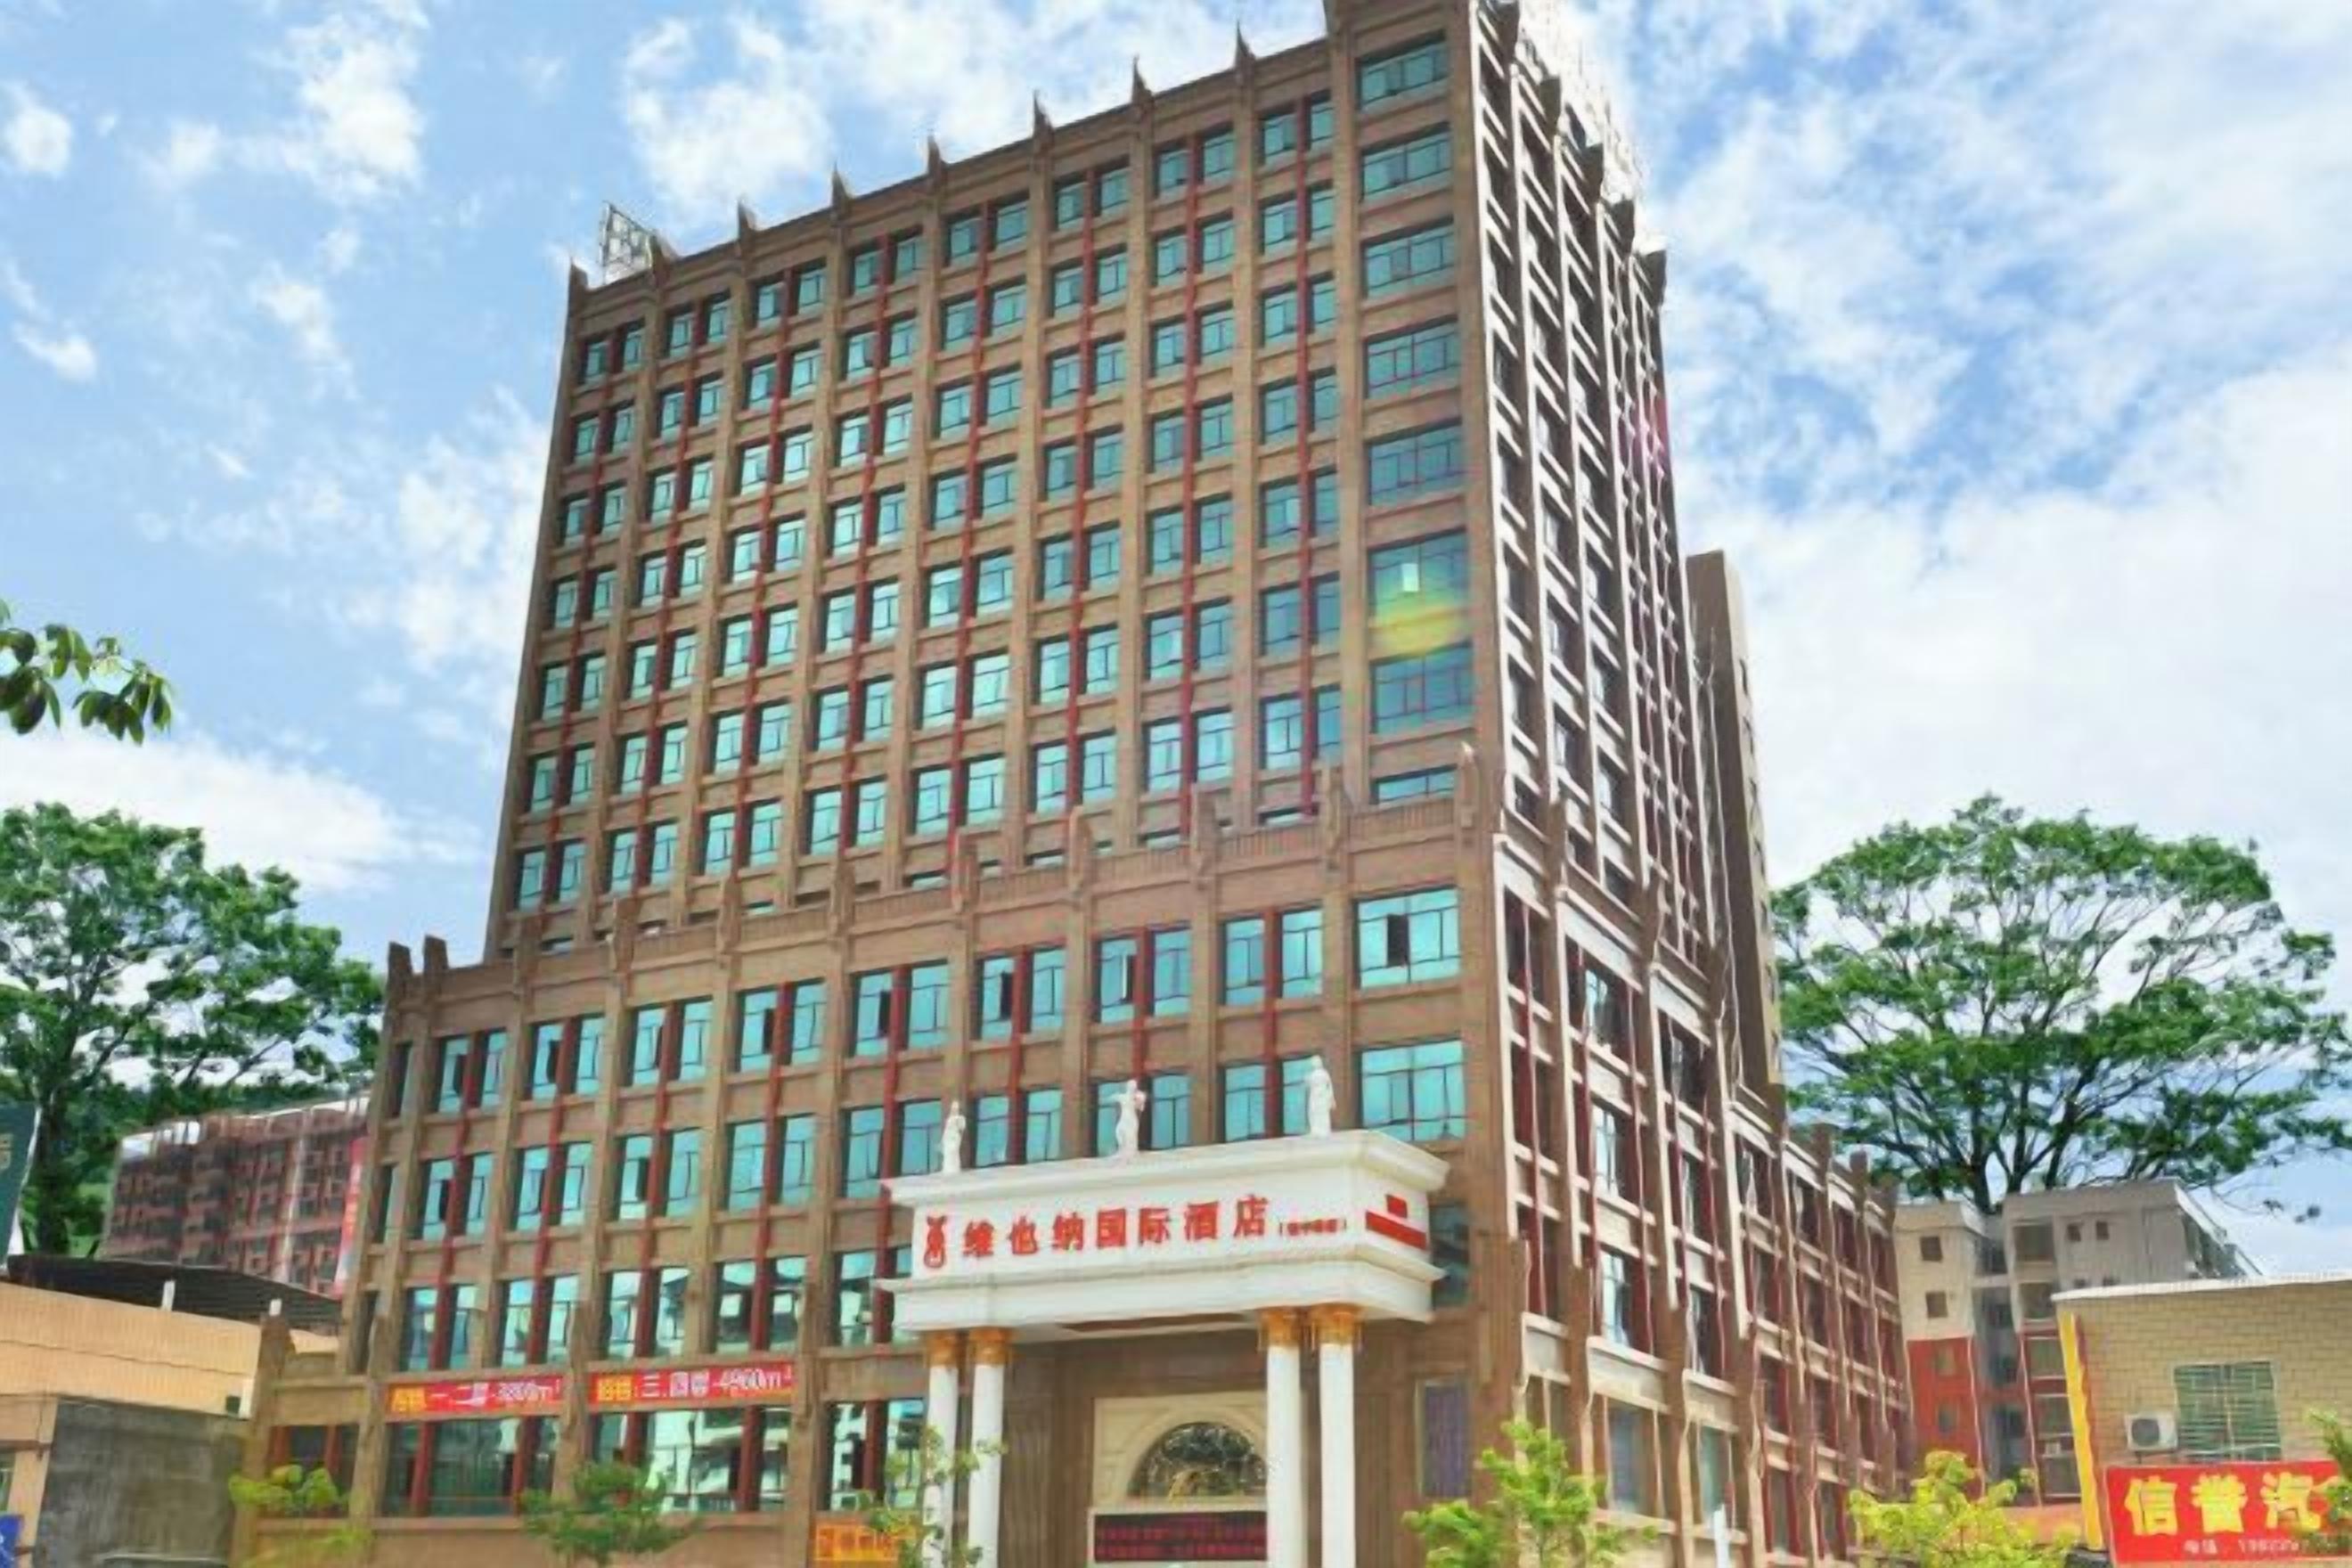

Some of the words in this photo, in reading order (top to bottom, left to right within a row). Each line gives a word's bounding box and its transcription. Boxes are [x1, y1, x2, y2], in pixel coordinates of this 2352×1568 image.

[962, 1194, 1268, 1258] 维也纳国际酒店
